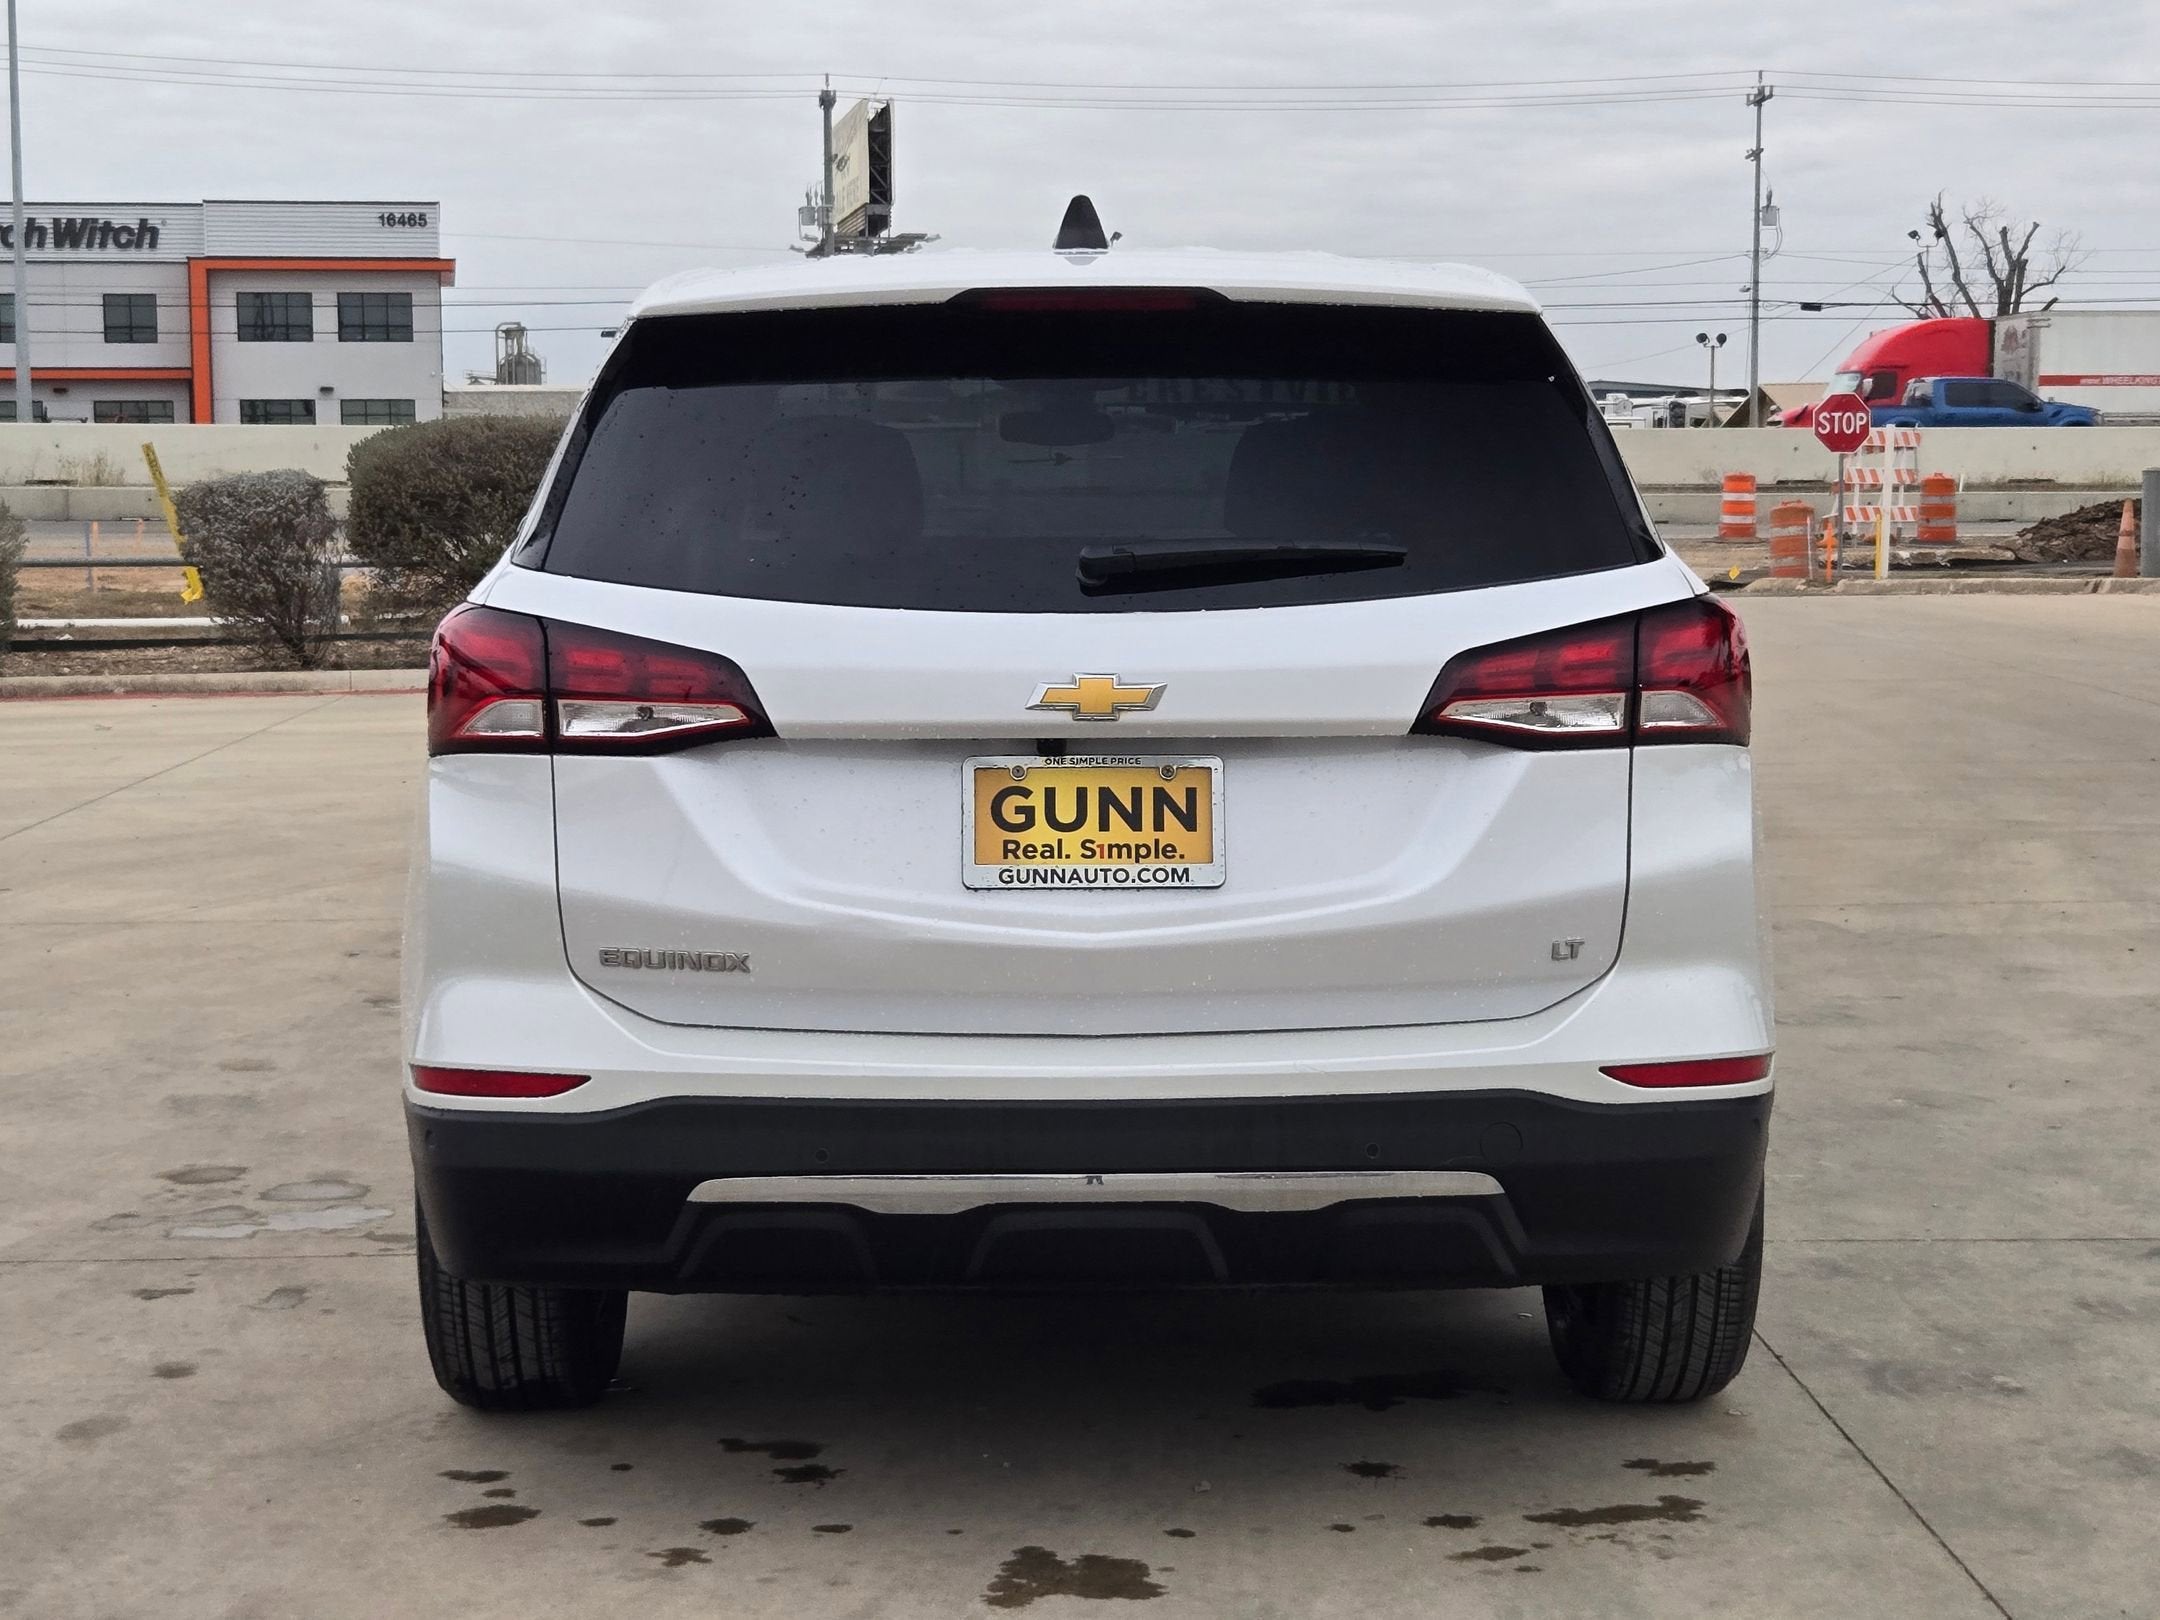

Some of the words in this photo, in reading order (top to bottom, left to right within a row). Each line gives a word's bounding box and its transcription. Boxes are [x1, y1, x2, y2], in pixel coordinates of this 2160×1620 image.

[378, 212, 428, 228] 16465
[52, 217, 160, 249] Witch
[1818, 411, 1867, 434] STOP
[1044, 757, 1066, 765] ONE
[1069, 757, 1108, 765] SIMPLE
[1110, 757, 1142, 765] PRICE
[990, 785, 1198, 833] GUNN
[1002, 838, 1071, 860] Real.
[998, 867, 1190, 884] GUNNAUTO.COM
[599, 947, 751, 973] EQUINOX
[1551, 938, 1585, 961] LT
